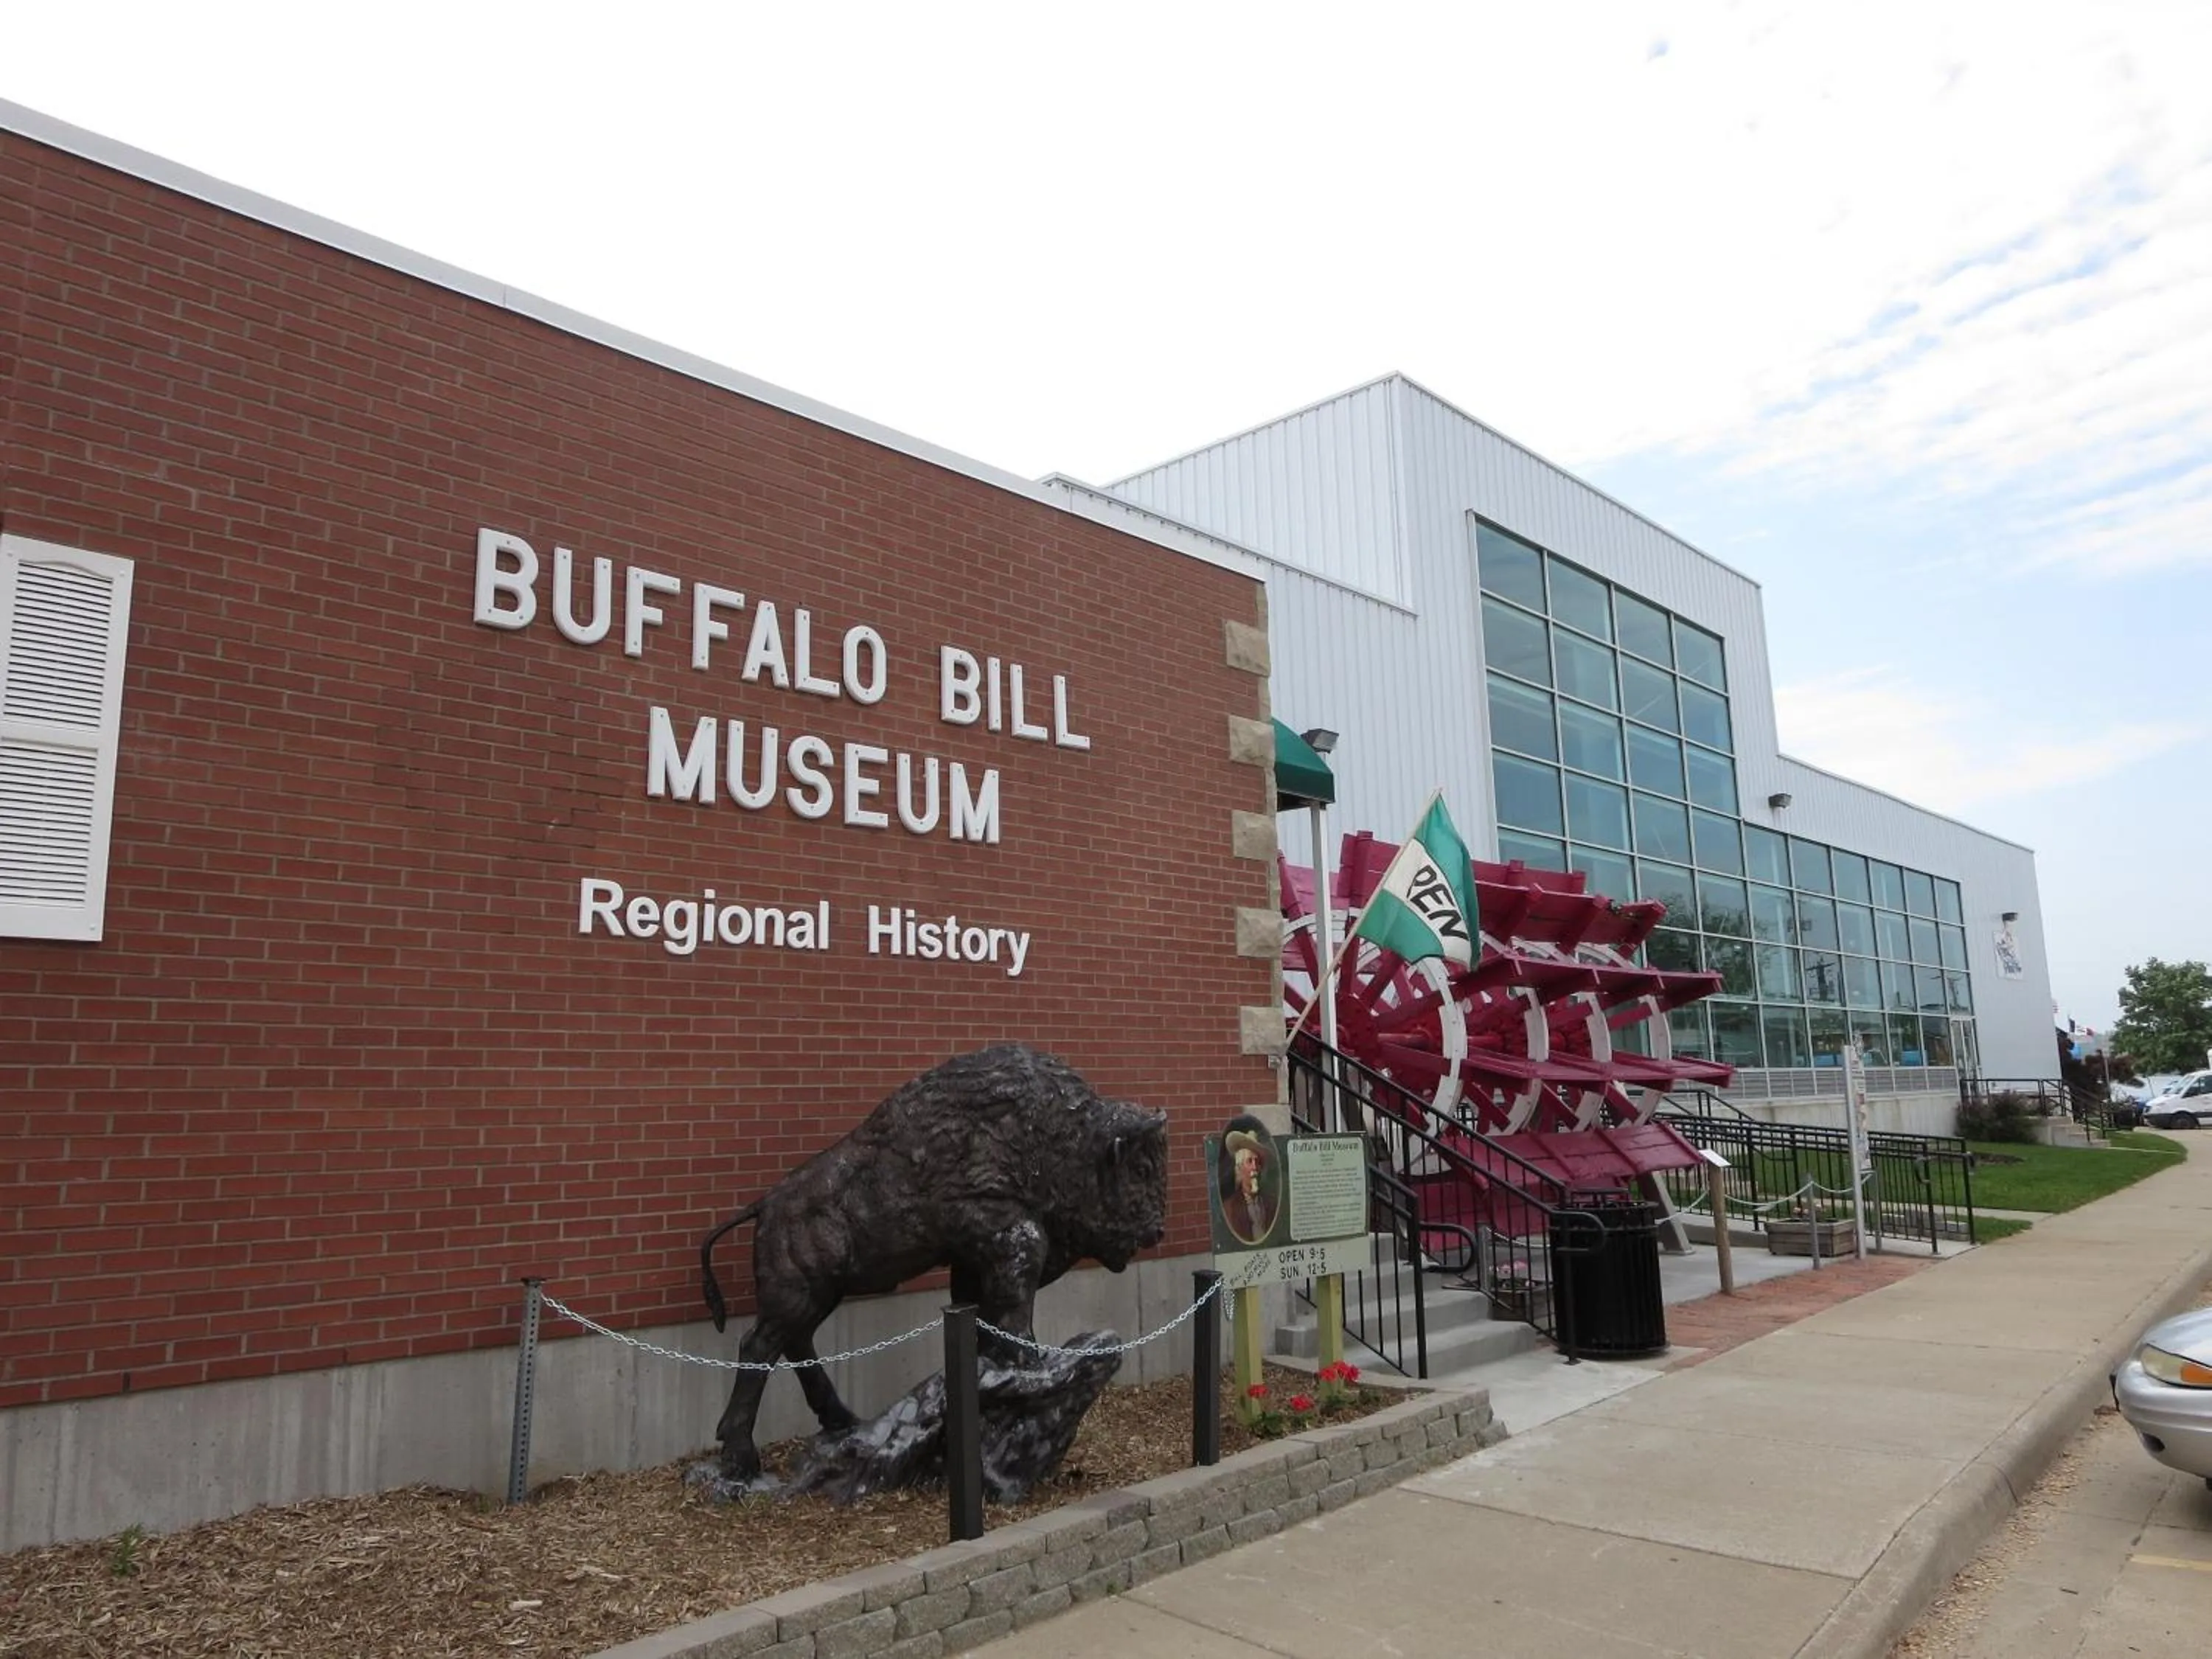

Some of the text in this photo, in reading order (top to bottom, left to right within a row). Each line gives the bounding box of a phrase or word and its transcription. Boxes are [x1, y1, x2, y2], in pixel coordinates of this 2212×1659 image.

[473, 527, 1091, 750] BUFFALO BILL
[647, 706, 1000, 844] MUSEUM
[578, 878, 1030, 977] Regional History
[1279, 1248, 1304, 1263] OPEN
